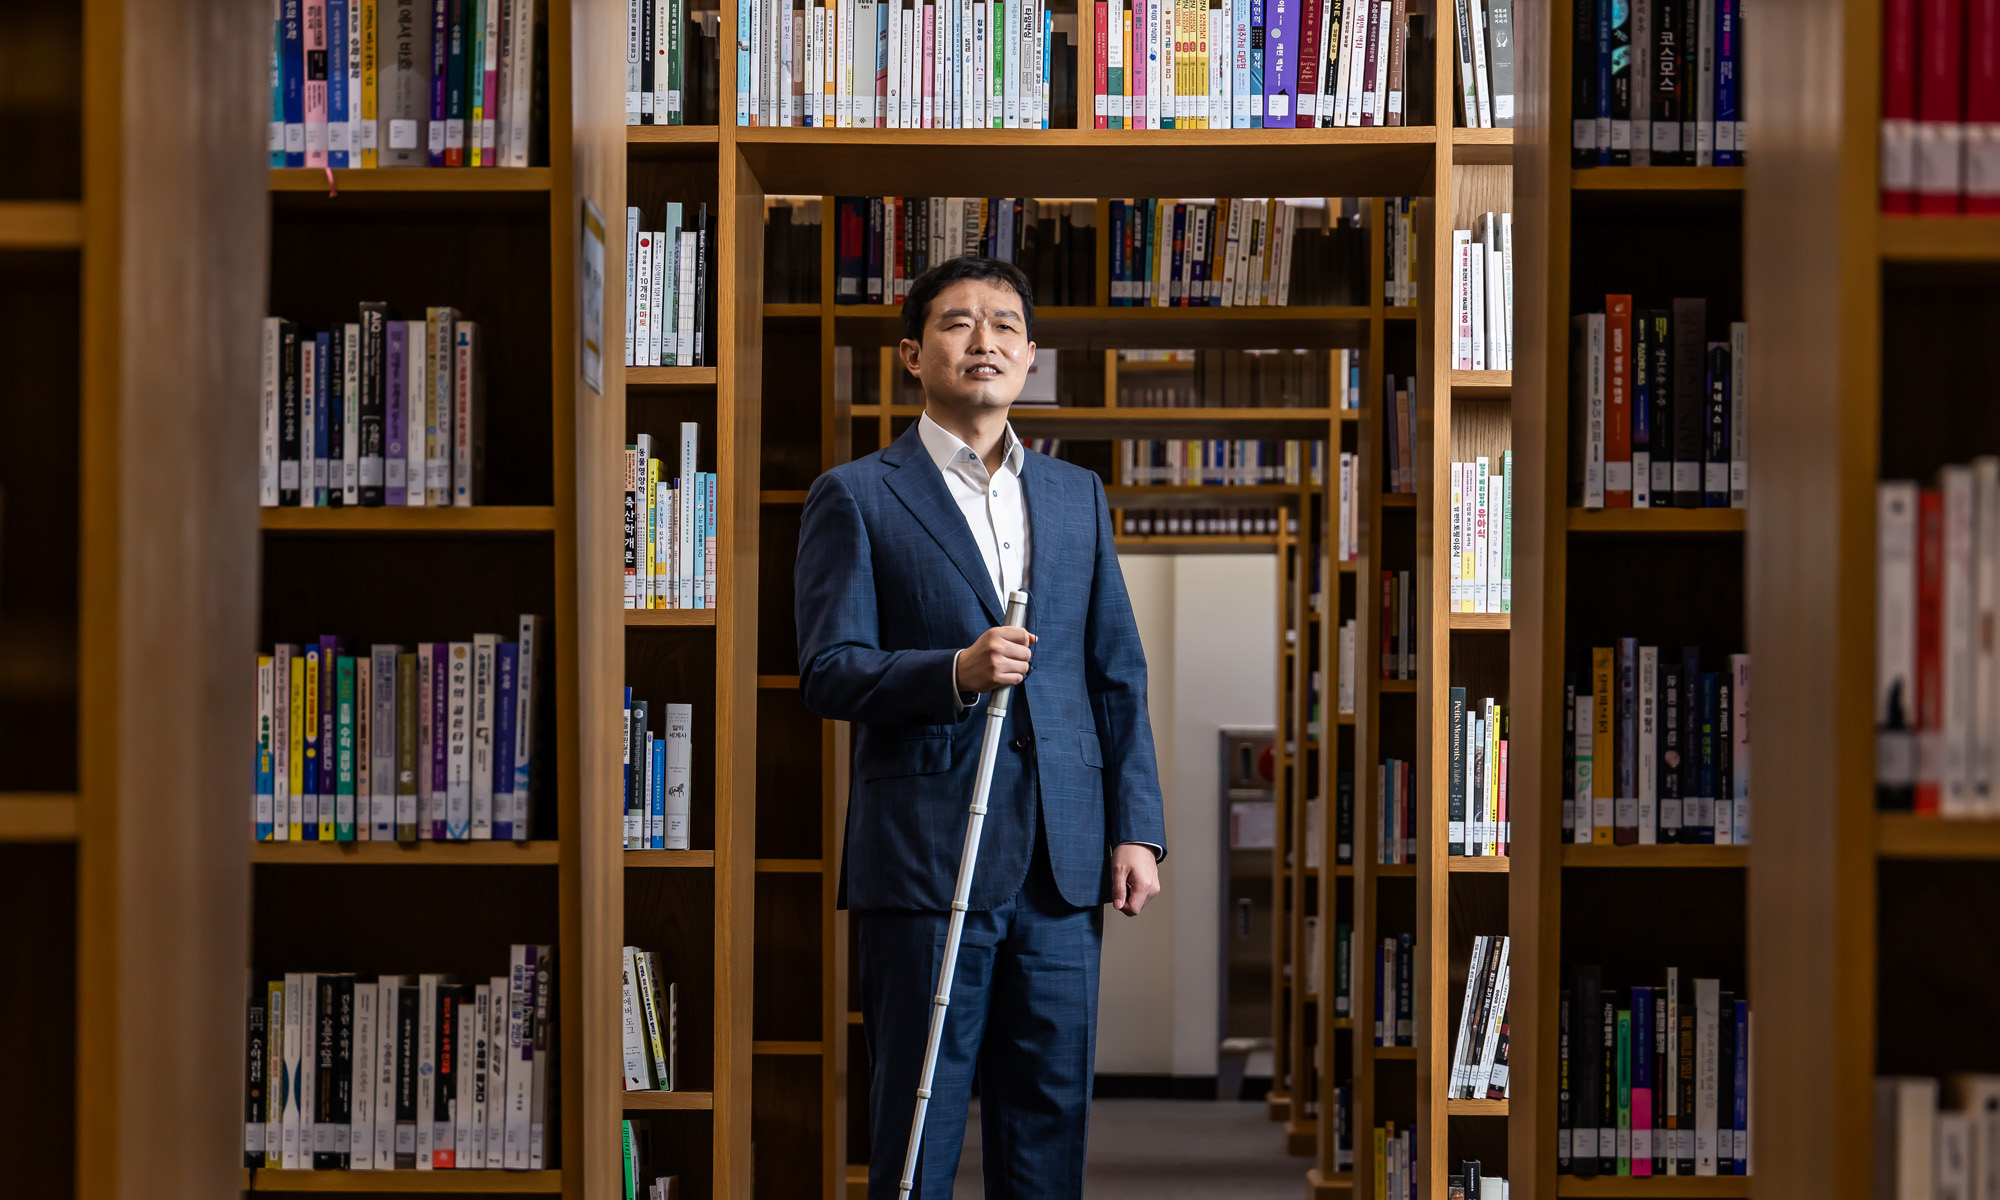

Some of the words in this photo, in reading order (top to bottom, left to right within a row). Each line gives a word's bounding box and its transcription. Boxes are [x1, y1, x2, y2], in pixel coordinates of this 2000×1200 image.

[1023, 7, 1032, 39] 타임박싱
[1150, 21, 1158, 44] 상식이다
[1236, 24, 1246, 49] 애주가의
[1236, 50, 1246, 69] 대모험
[1659, 31, 1675, 91] 코스모스
[965, 202, 980, 230] PALO
[639, 302, 647, 326] 토마토
[1461, 311, 1469, 324] 100
[638, 448, 646, 494] 동물영양학
[1477, 508, 1486, 539] 유아식
[1453, 700, 1462, 723] Petits
[671, 724, 684, 732] 말의
[1453, 723, 1462, 761] Moments
[1453, 768, 1461, 786] Table
[1680, 1015, 1693, 1029] THE
[1680, 1030, 1693, 1056] WORLD
[1680, 1057, 1693, 1080] ITSELF
